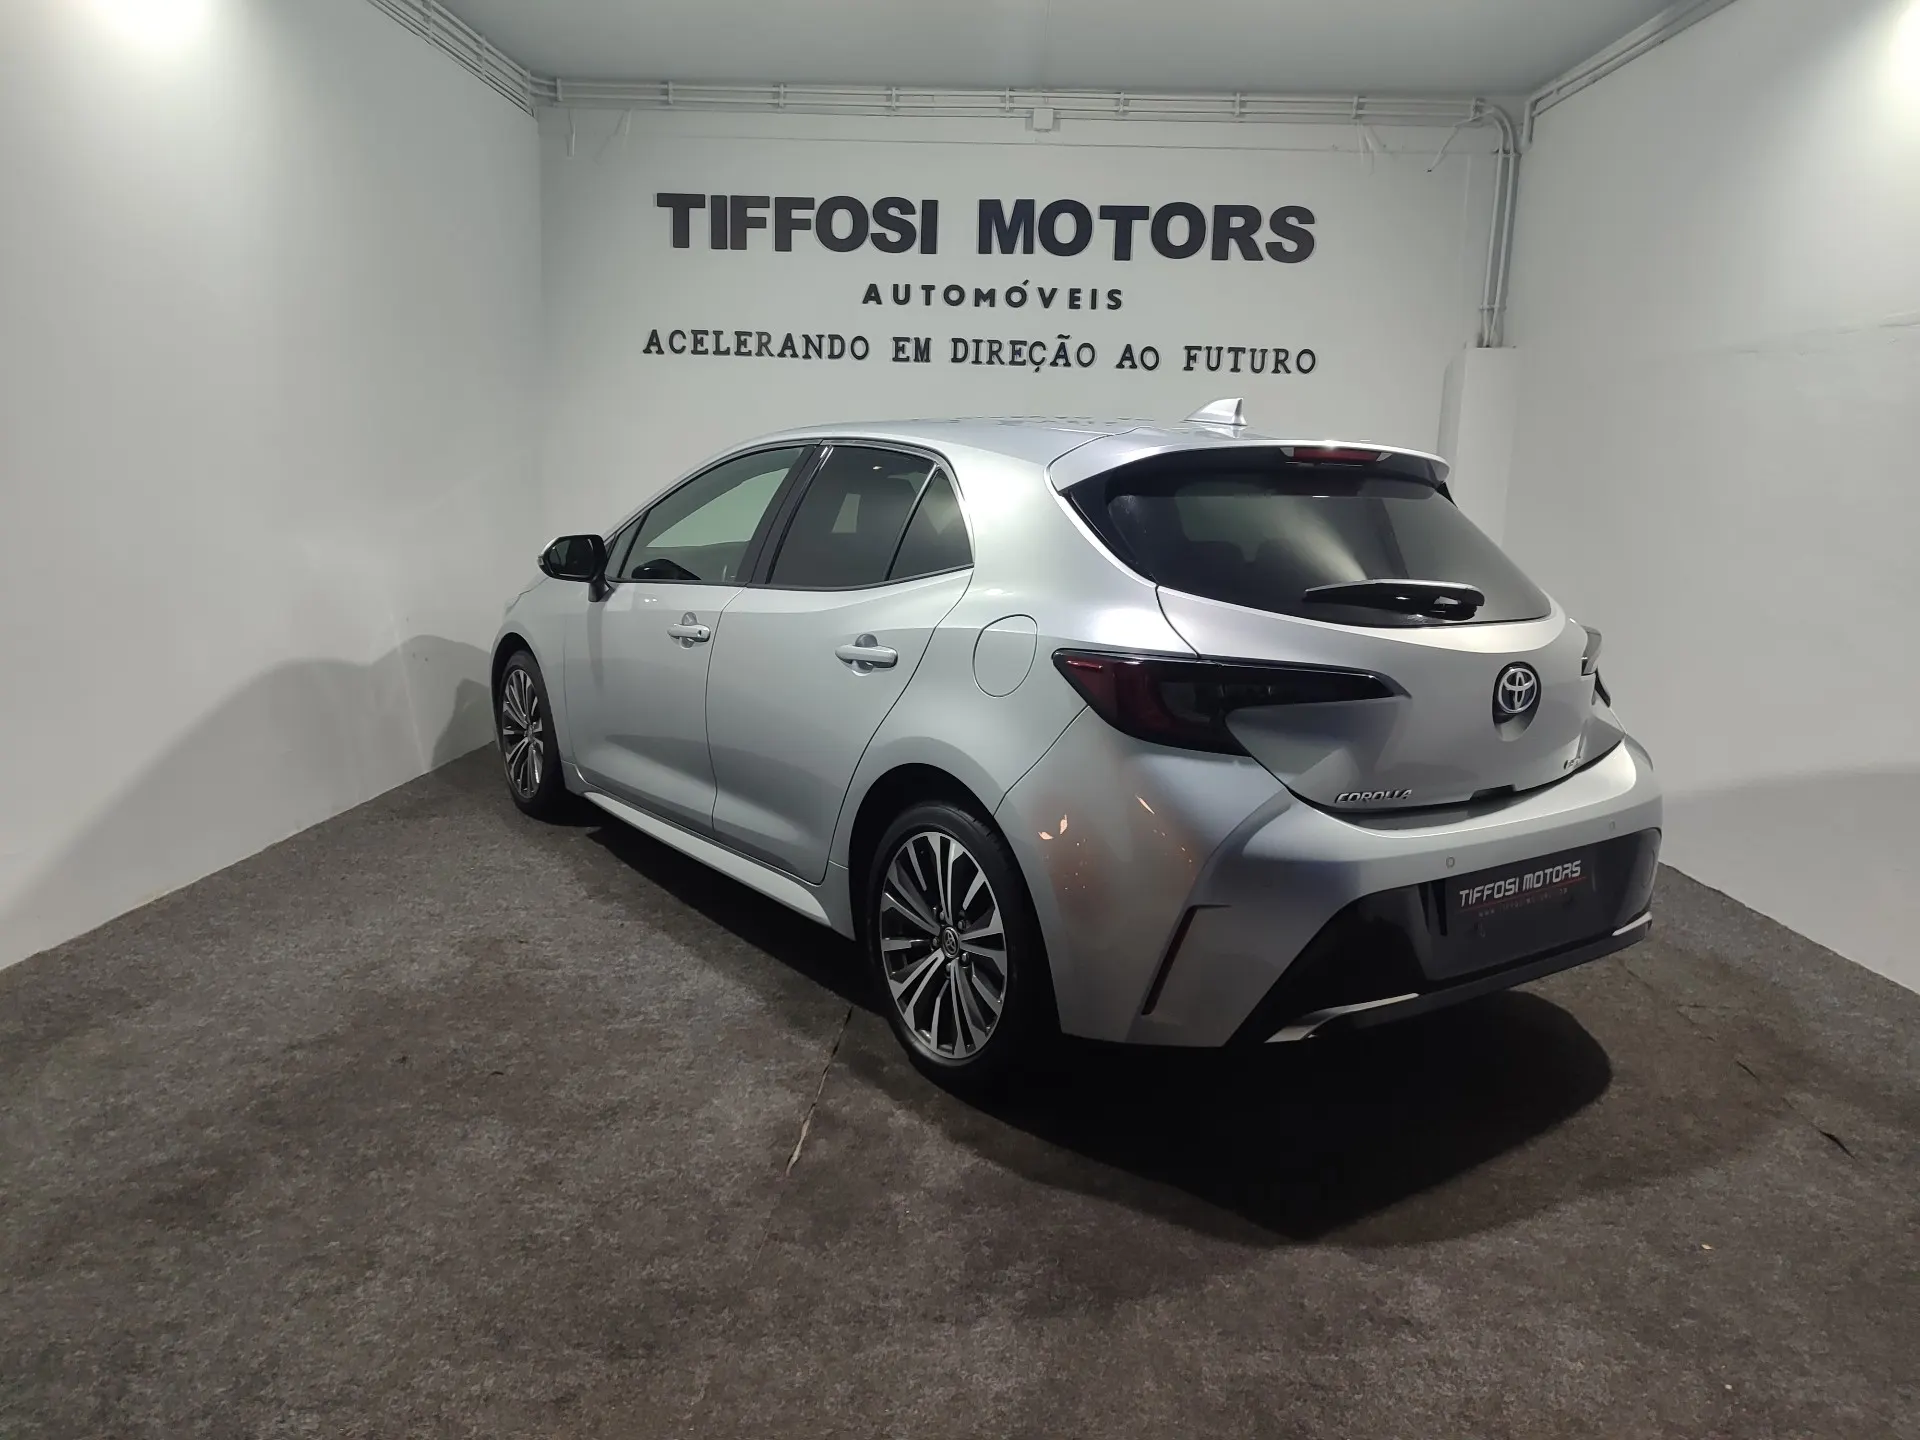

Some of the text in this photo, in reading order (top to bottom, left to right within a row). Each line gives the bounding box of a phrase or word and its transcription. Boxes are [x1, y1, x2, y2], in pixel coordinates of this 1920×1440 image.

[656, 192, 1317, 264] TIFFOSI MOTORS
[861, 279, 1124, 311] AUTOMÓVEIS
[642, 329, 1318, 375] ACELERANDO EM DIREÇÃO AO FUTURO
[1335, 788, 1412, 803] COROLLA
[1459, 876, 1520, 907] TIFFOSI
[1522, 859, 1582, 892] MOTORS
